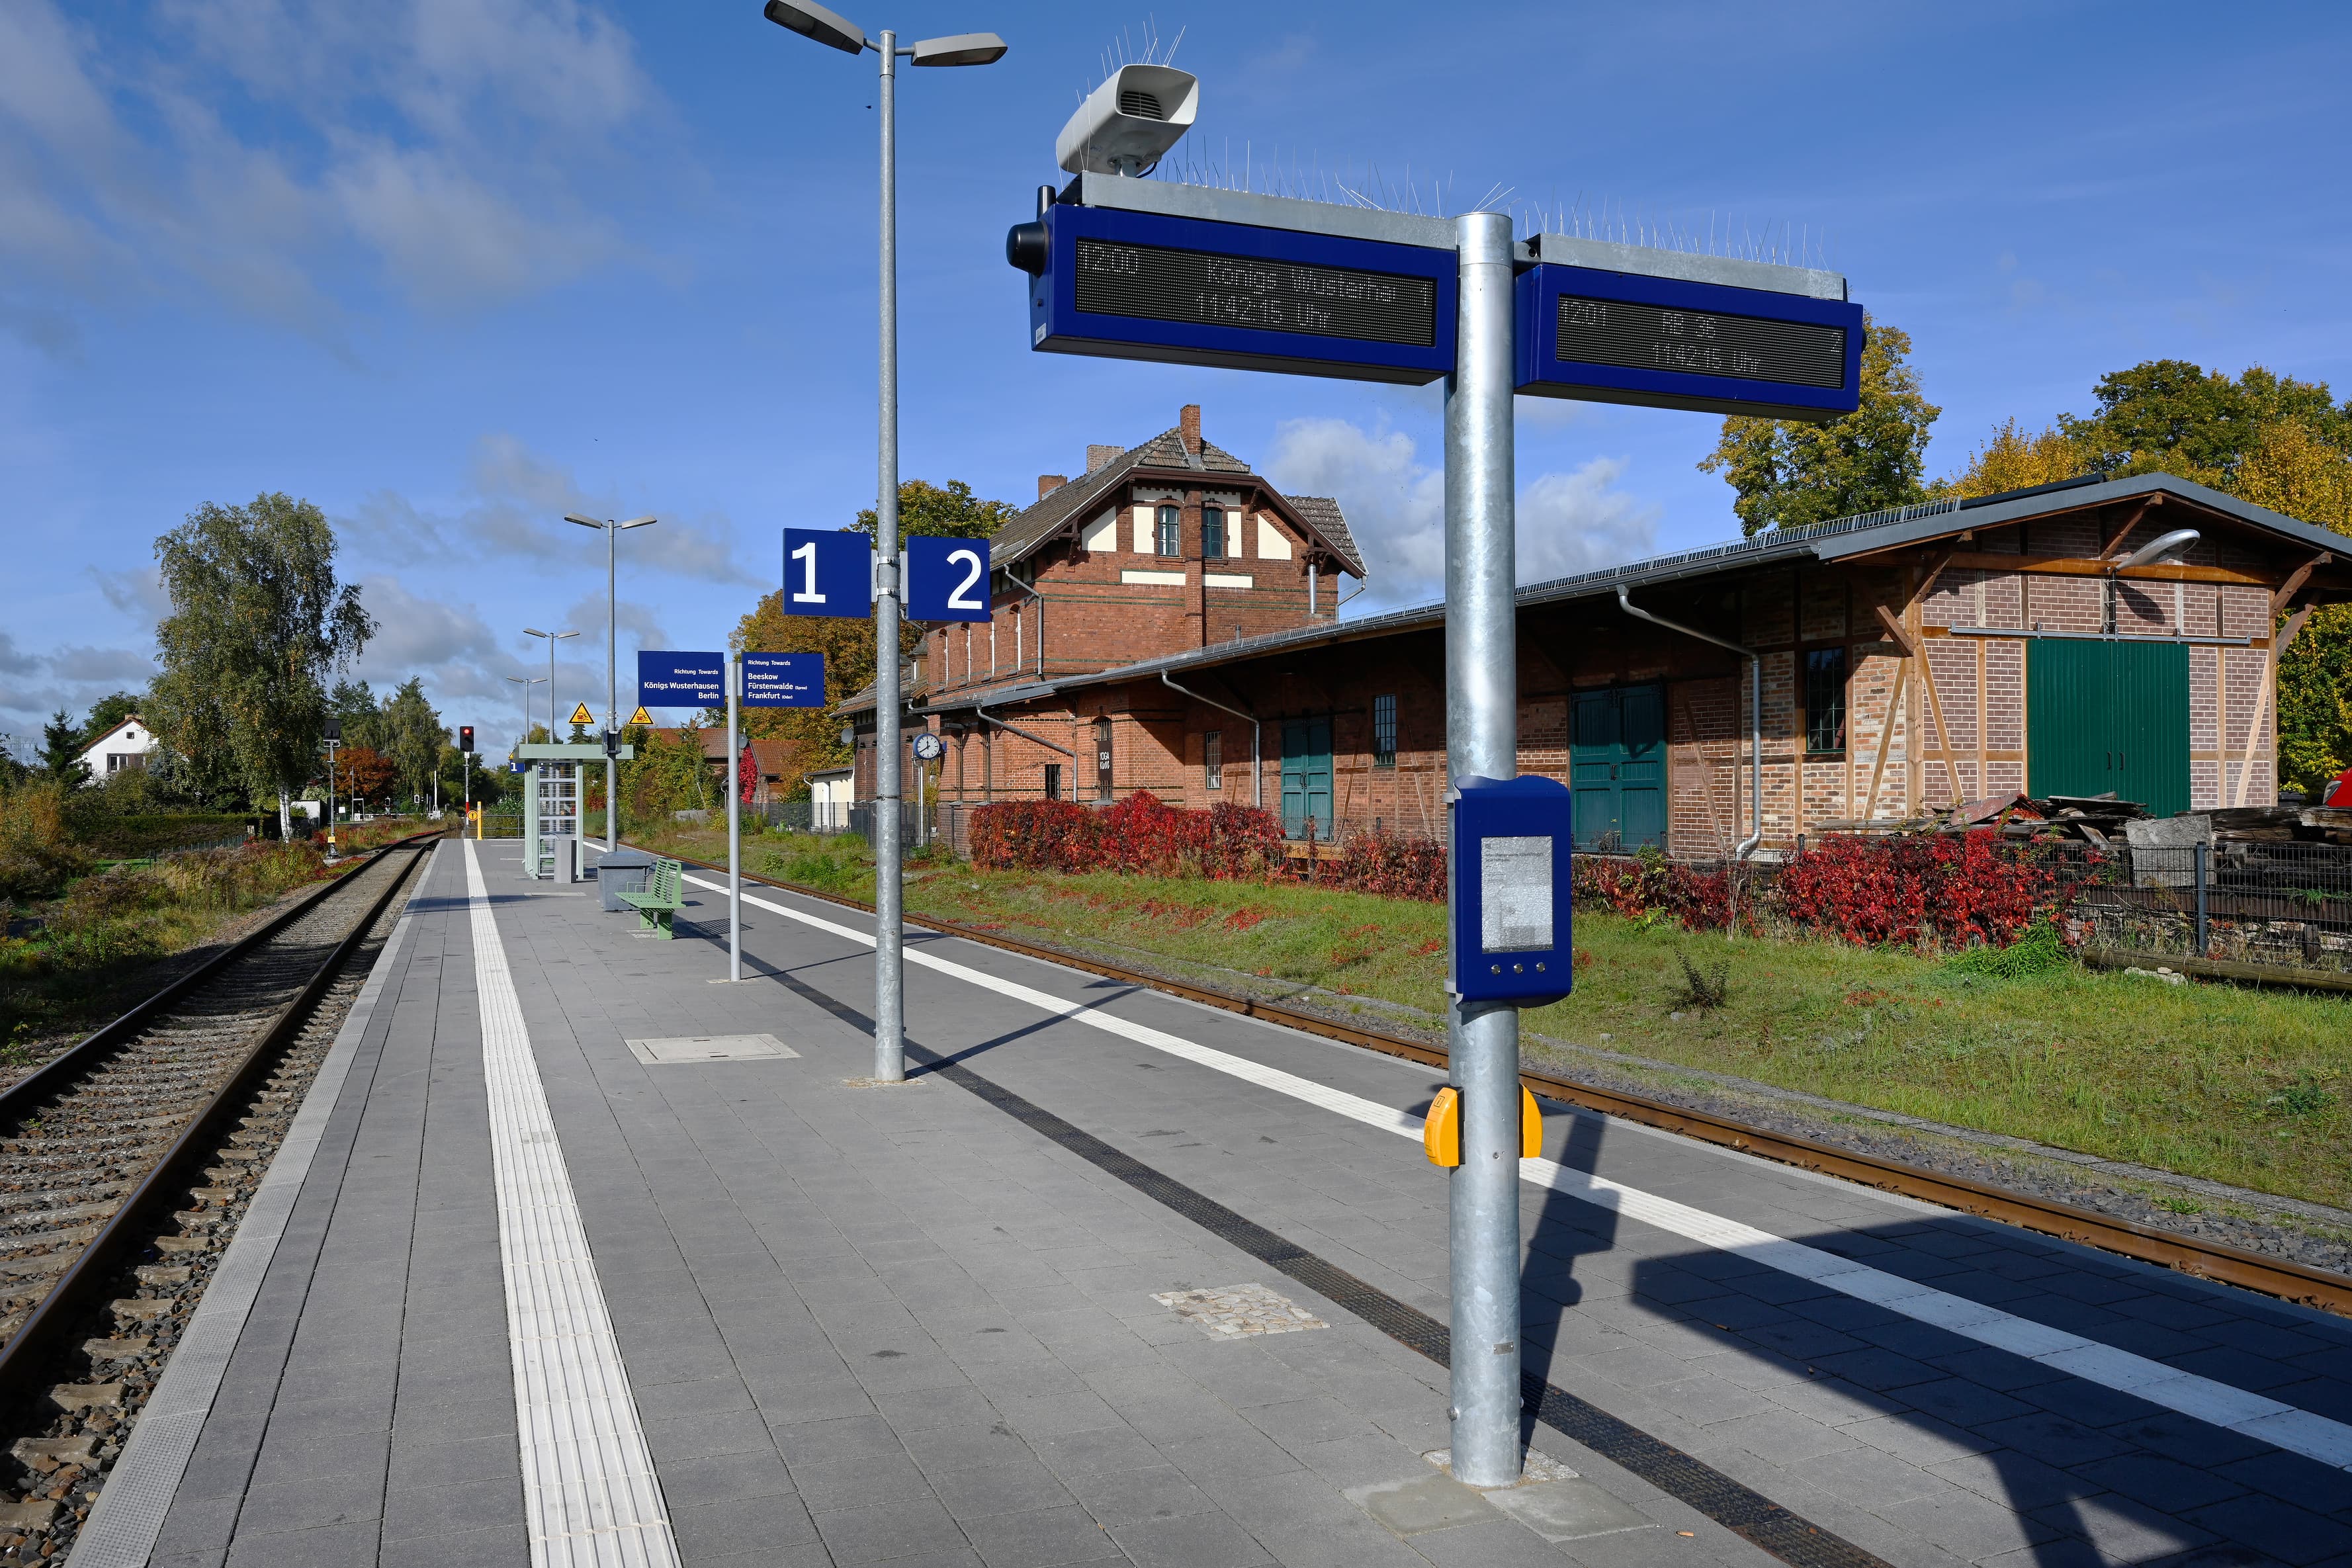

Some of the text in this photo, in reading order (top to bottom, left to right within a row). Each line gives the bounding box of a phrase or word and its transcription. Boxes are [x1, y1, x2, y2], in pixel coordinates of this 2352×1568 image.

[1291, 268, 1395, 302] Wusterha
[1297, 302, 1330, 328] Uhr
[1662, 312, 1684, 335] RB
[1695, 316, 1716, 338] 36
[1831, 331, 1840, 353] 2
[1733, 350, 1761, 372] Uhr
[793, 543, 825, 603] 1
[947, 550, 982, 609] 2
[511, 762, 517, 771] 1
[1099, 752, 1110, 760] YOGA
